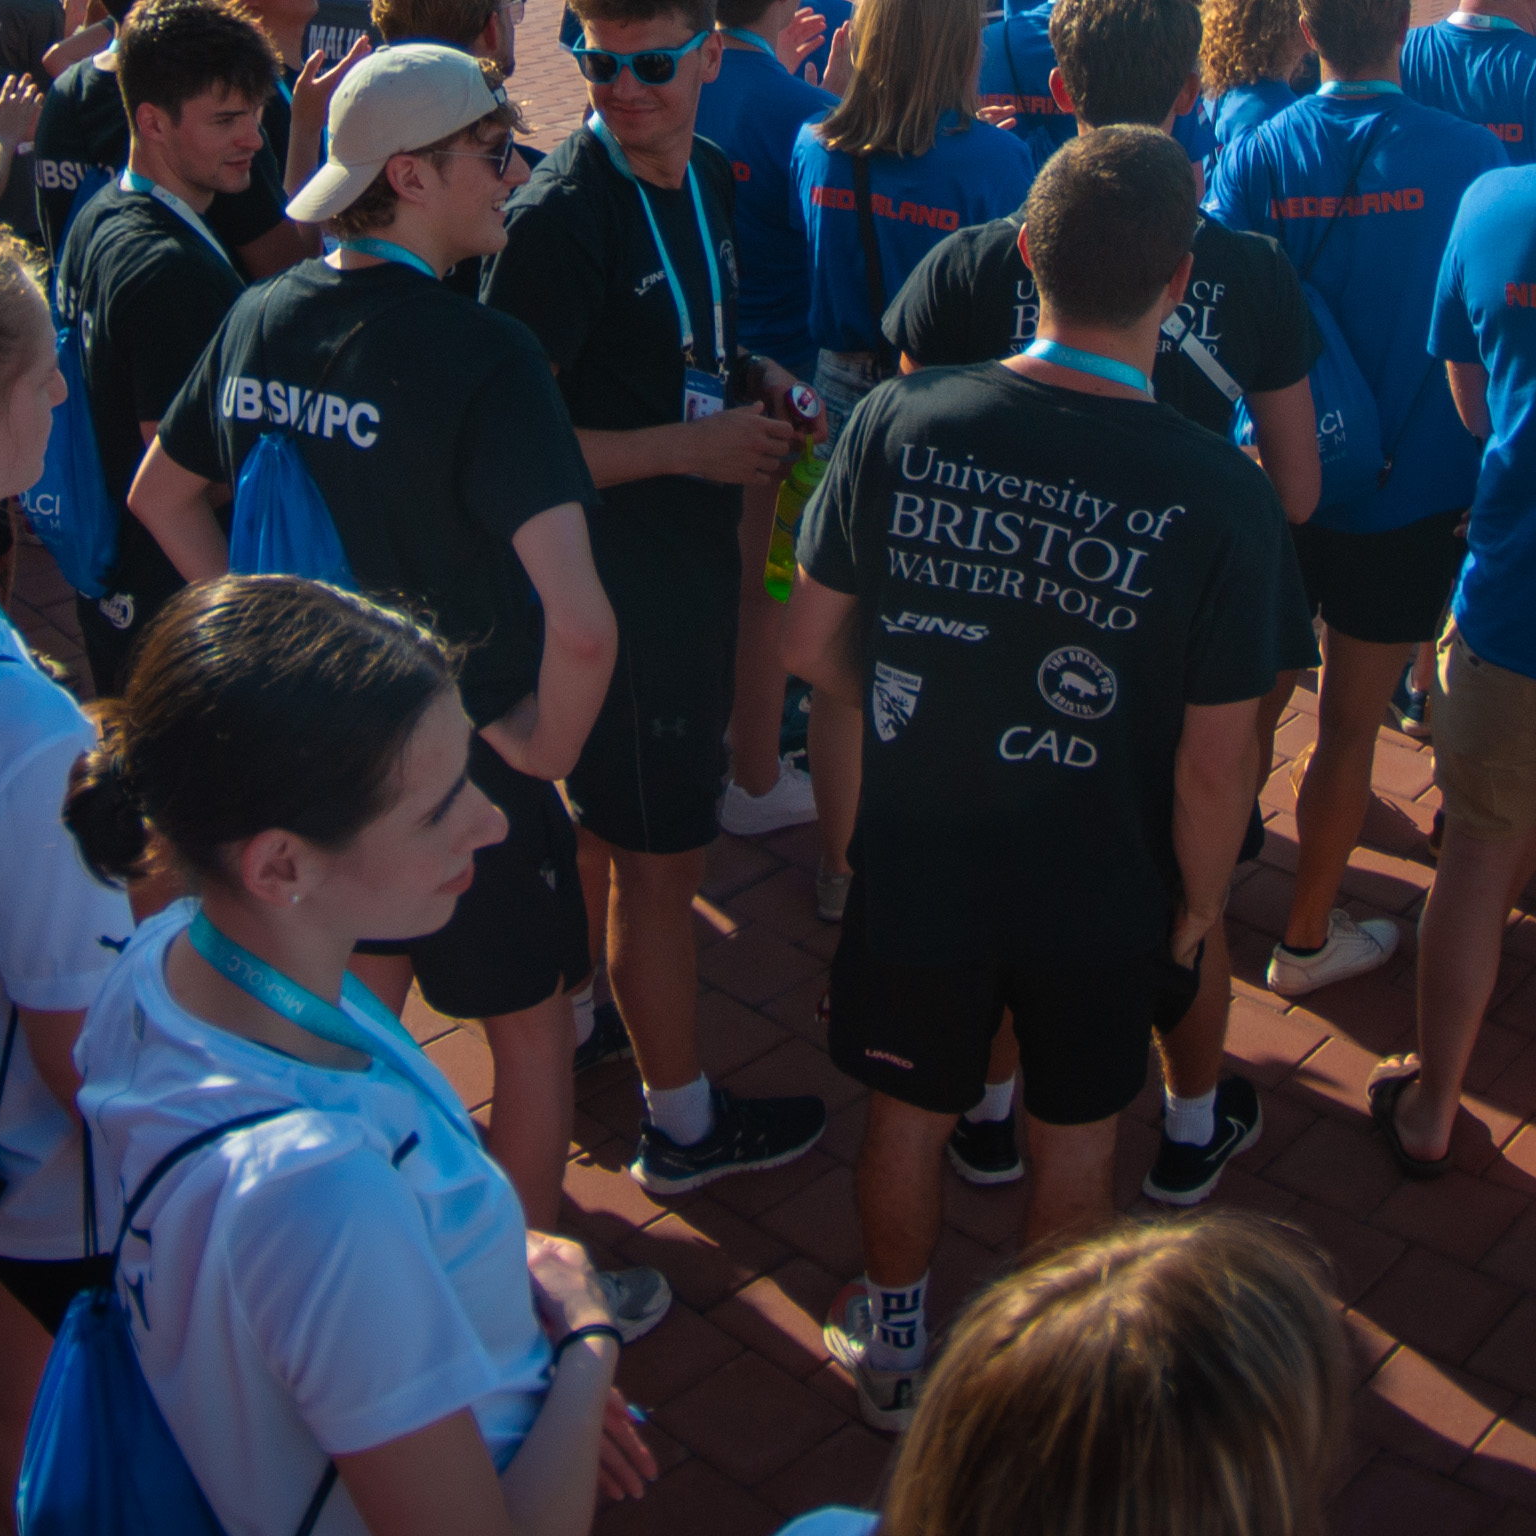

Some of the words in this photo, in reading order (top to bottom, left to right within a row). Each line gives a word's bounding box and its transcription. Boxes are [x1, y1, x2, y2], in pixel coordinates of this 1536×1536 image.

[810, 186, 960, 232] NEDRLAND
[222, 376, 381, 448] UBSWPC
[900, 443, 1117, 533] University
[1127, 505, 1186, 541] of
[888, 491, 1153, 598] BRISTOL
[887, 547, 1026, 599] WATER
[1033, 577, 1138, 631] POLO
[896, 610, 990, 641] FINIS
[1047, 653, 1068, 671] THE
[1068, 651, 1103, 677] BRASS
[1099, 677, 1113, 694] PIG
[1050, 692, 1095, 714] BRISTOL
[999, 726, 1099, 767] CAD
